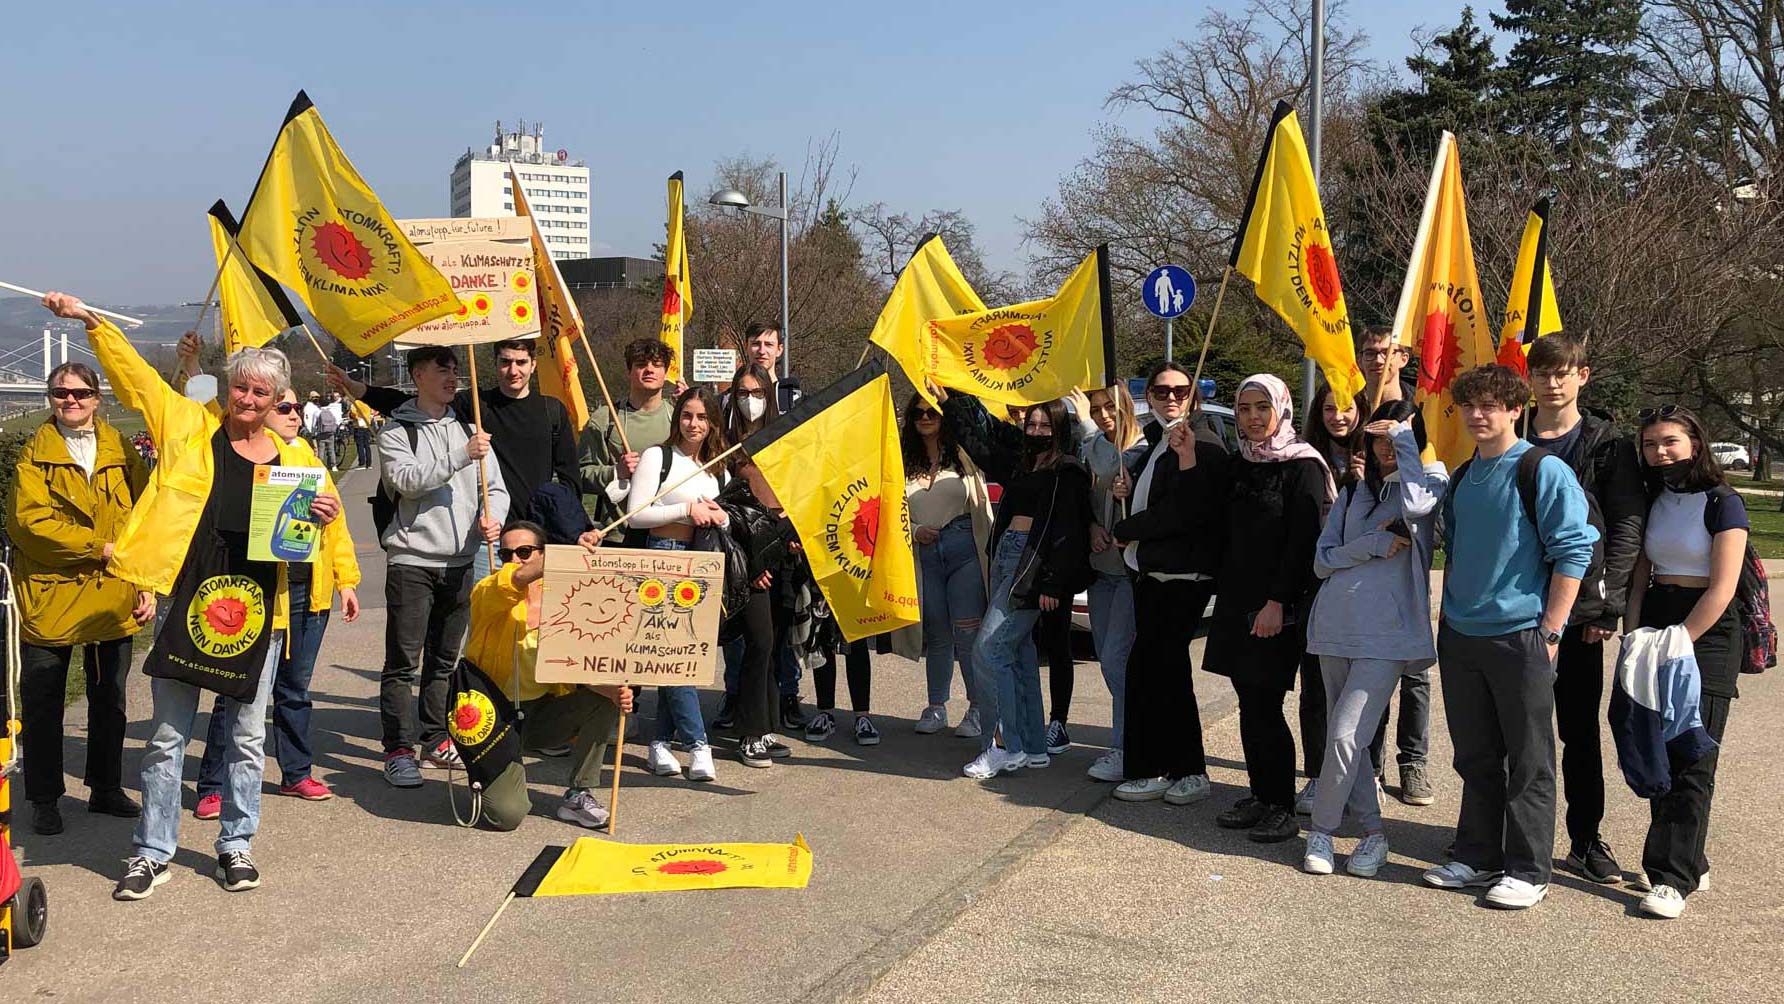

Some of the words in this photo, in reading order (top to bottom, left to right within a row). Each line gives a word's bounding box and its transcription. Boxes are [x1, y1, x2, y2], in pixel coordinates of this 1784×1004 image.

[337, 208, 401, 274] ATOMKRAFT?
[313, 278, 358, 297] KLIMA
[360, 282, 389, 297] NIX!
[1291, 275, 1313, 309] DEM
[830, 477, 869, 522] NUTZT
[826, 524, 839, 553] DEM
[591, 556, 637, 571] atomstopp
[652, 559, 682, 574] future
[198, 578, 263, 615] ATOMKRAFT?
[190, 614, 211, 649] NEIN
[212, 628, 257, 656] DANKE
[644, 617, 679, 630] AKW
[645, 632, 660, 640] als
[583, 656, 627, 673] NEIN
[477, 708, 493, 739] DANKE
